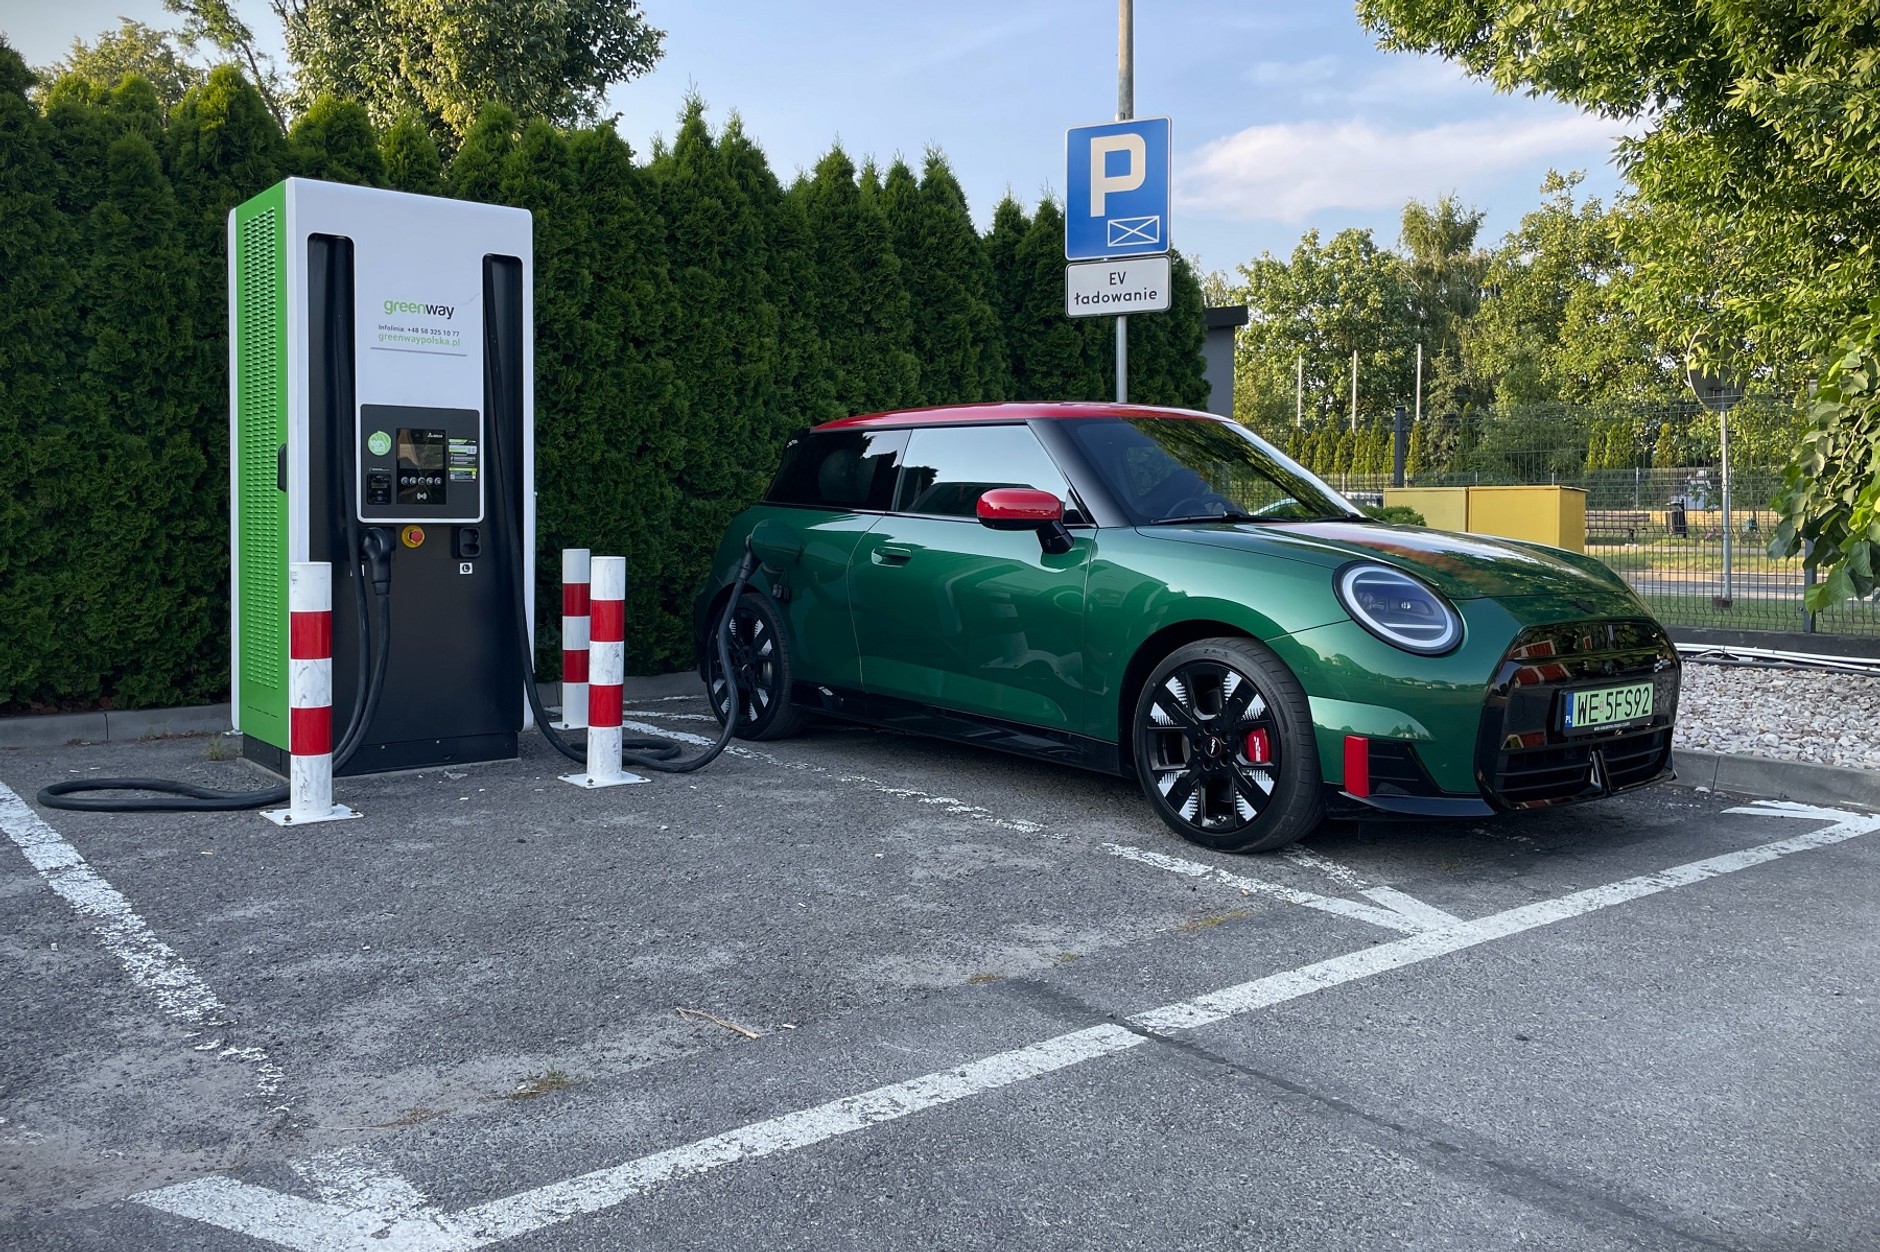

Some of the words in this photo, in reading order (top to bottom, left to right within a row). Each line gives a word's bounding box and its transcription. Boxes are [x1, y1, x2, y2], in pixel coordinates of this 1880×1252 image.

[1091, 133, 1146, 217] P
[1109, 271, 1127, 286] EV
[1074, 287, 1158, 306] ładowanie
[384, 300, 454, 319] greenway
[378, 333, 460, 347] greenwaypolska.pl
[430, 328, 442, 336] 325
[443, 329, 451, 337] 10
[1577, 693, 1599, 724] WE
[1605, 686, 1650, 721] 5FS92
[1565, 715, 1572, 724] PL
